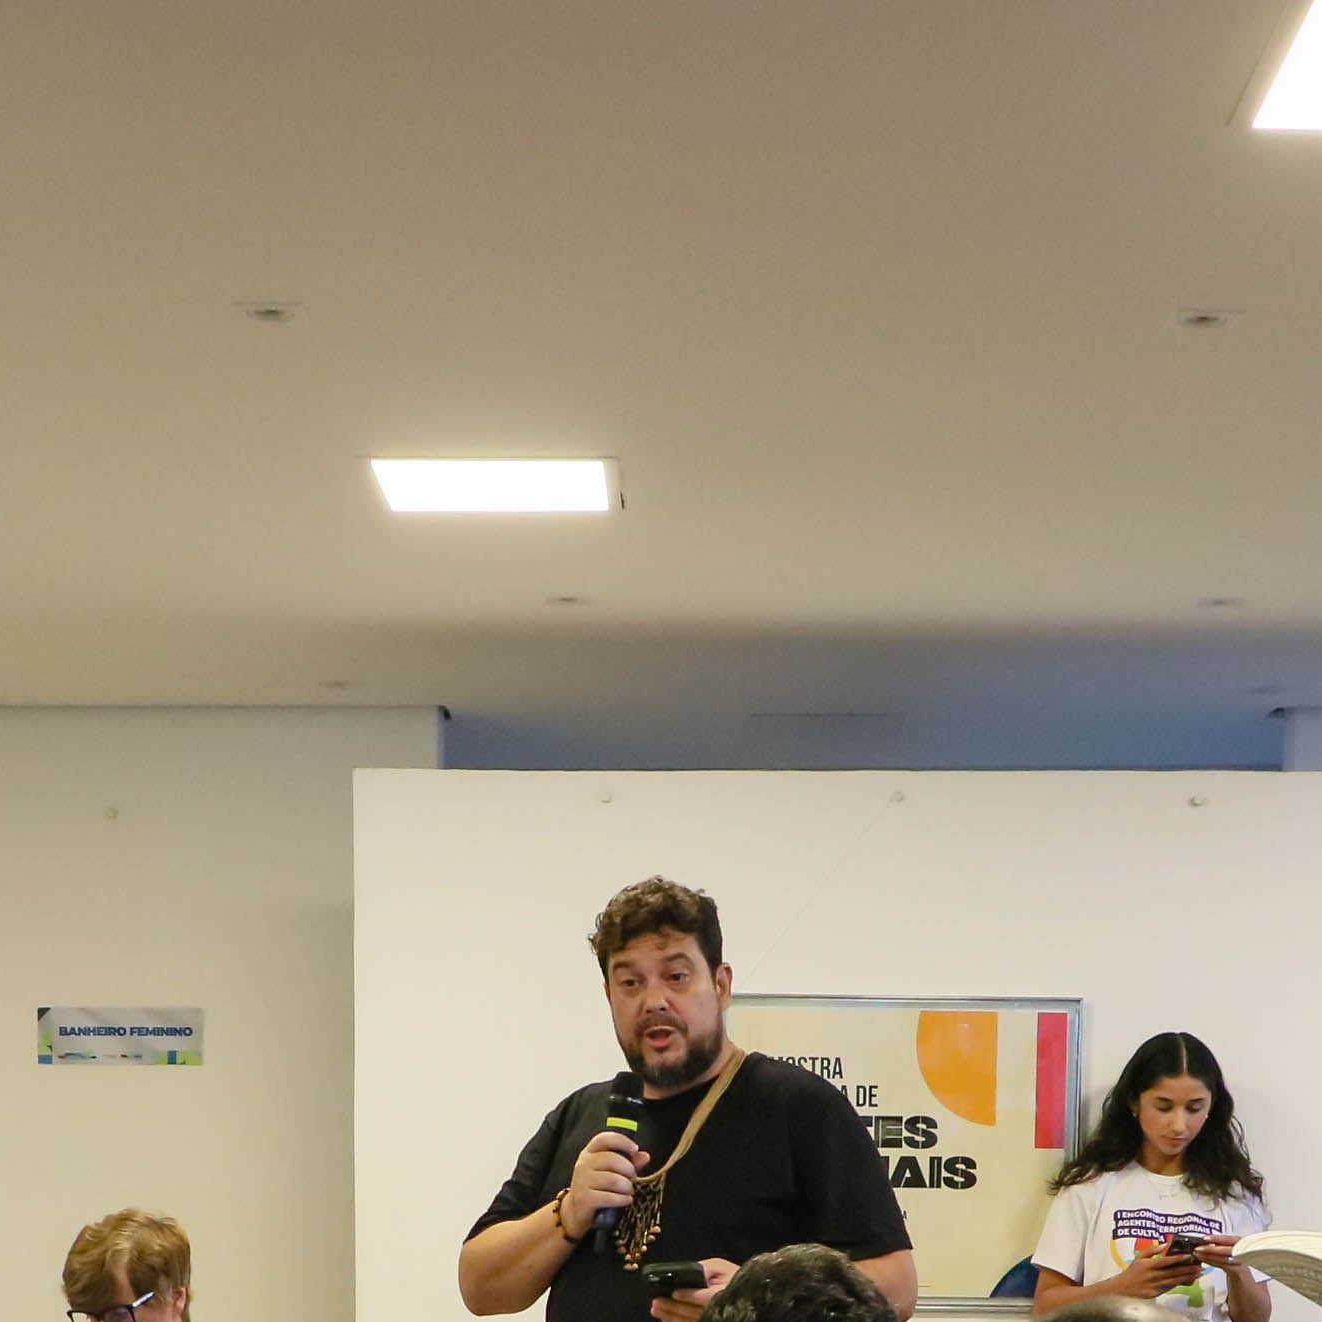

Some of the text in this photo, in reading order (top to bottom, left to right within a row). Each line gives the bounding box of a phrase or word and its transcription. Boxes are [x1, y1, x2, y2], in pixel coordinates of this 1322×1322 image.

[58, 1026, 194, 1037] BANHEIRO FEMININO
[1117, 1219, 1157, 1229] AGENTES
[1122, 1210, 1166, 1223] ENCONTRO
[1167, 1215, 1207, 1226] REGIONAL
[1209, 1221, 1220, 1229] DE
[1117, 1228, 1129, 1236] DE
